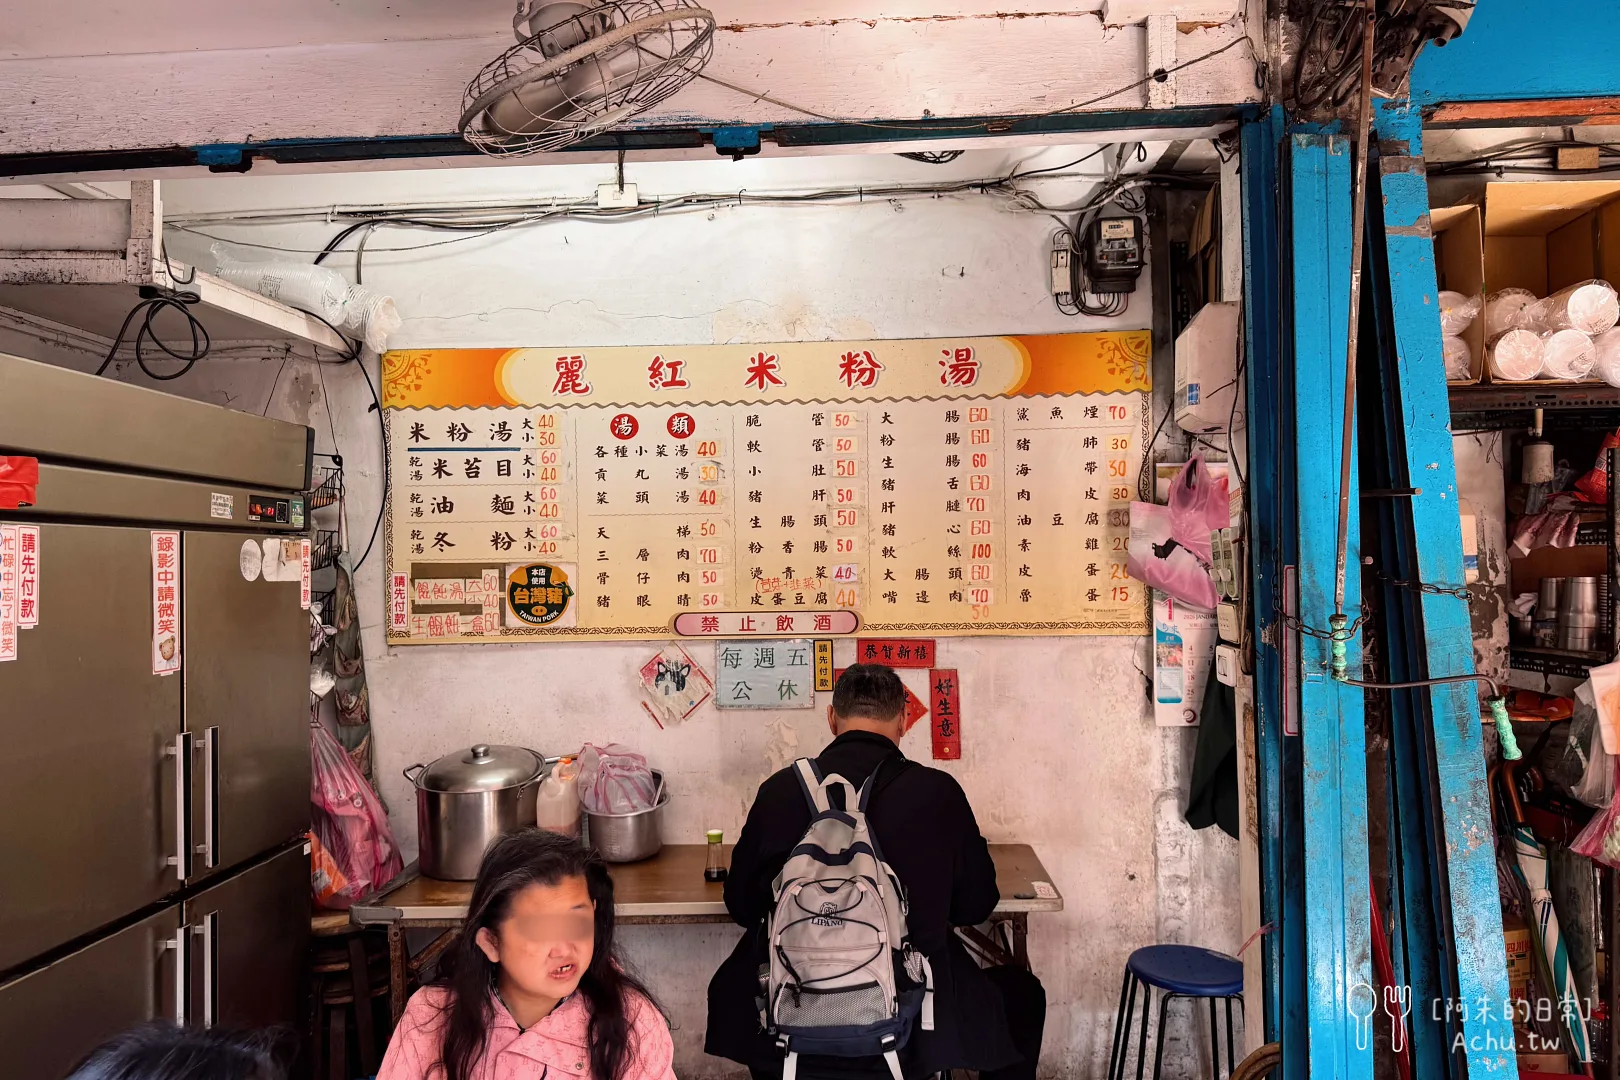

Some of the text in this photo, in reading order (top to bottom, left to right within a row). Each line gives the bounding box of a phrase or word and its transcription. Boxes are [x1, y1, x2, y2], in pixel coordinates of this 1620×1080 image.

[552, 348, 978, 395] 麗紅米粉湯
[746, 413, 850, 427] 脆管 50
[881, 407, 988, 424] 大腸 60
[1017, 405, 1126, 421] 鯊魚煙 70
[522, 414, 554, 430] 大 40
[614, 415, 689, 436] 湯類
[408, 420, 513, 443] 米粉湯
[522, 431, 555, 446] 小 30
[880, 429, 990, 447] 粉腸 60
[594, 441, 717, 458] 各種小菜湯 40
[747, 438, 852, 453] 軟管 50
[1016, 436, 1128, 452] 豬肺 30
[522, 450, 557, 466] 大 60
[881, 453, 987, 469] 生腸 60
[431, 457, 513, 479] 米苔目
[522, 467, 557, 481] 小 40
[595, 466, 716, 482] 貢丸湯 30
[748, 460, 855, 477] 小肚 50
[1015, 461, 1098, 477] 海帶
[881, 474, 990, 491] 豬舌 60
[523, 486, 556, 503] 大 60
[596, 489, 716, 505] 菜頭湯 40
[748, 488, 853, 503] 豬肝 50
[1017, 487, 1128, 501] 肉皮 30
[430, 493, 516, 515] 油麵
[523, 503, 558, 518] 小 40
[966, 497, 985, 512] 70
[749, 509, 856, 529] 生腸頭 50
[1017, 511, 1130, 527] 油豆腐 30
[523, 525, 557, 539] 大 60
[596, 522, 716, 539] 天梯 50
[882, 519, 991, 537] 豬心 60
[430, 530, 517, 552] 冬粉
[523, 541, 556, 555] 小 40
[748, 539, 853, 554] 粉香腸 50
[1018, 537, 1099, 552] 素雞
[597, 548, 717, 563] 三層肉 70
[881, 543, 991, 559] 軟絲 100
[20, 533, 36, 618] 請先付款
[302, 544, 310, 602] 請先付款
[531, 568, 546, 576] 本店
[597, 570, 717, 585] 骨仔肉 50
[750, 565, 852, 580] 燙青菜 40
[883, 564, 990, 581] 大腸頭 60
[1018, 563, 1100, 577] 皮蛋
[156, 536, 175, 635] 錄影中請微笑
[468, 573, 498, 593] 大 60
[531, 577, 546, 585] 使用
[2, 535, 15, 653] 忙碌中忘了微笑
[416, 581, 464, 601] 餛飩湯
[513, 587, 564, 605] 台灣豬
[750, 588, 856, 608] 皮蛋豆腐 40
[882, 588, 989, 604] 嘴邊肉 70
[1111, 587, 1129, 602] 15
[393, 575, 406, 625] 請先付款
[467, 594, 499, 609] 小 40
[597, 593, 718, 608] 豬眼睛 50
[519, 609, 559, 623] TAIWAN PORK
[971, 604, 990, 620] 50
[484, 612, 500, 633] 60
[701, 614, 832, 633] 禁止飲酒
[720, 646, 809, 669] 每週五
[864, 643, 928, 660] 恭賀新禧
[818, 643, 829, 688] 請先付款
[731, 679, 799, 701] 公休
[934, 677, 955, 737] 好生意
